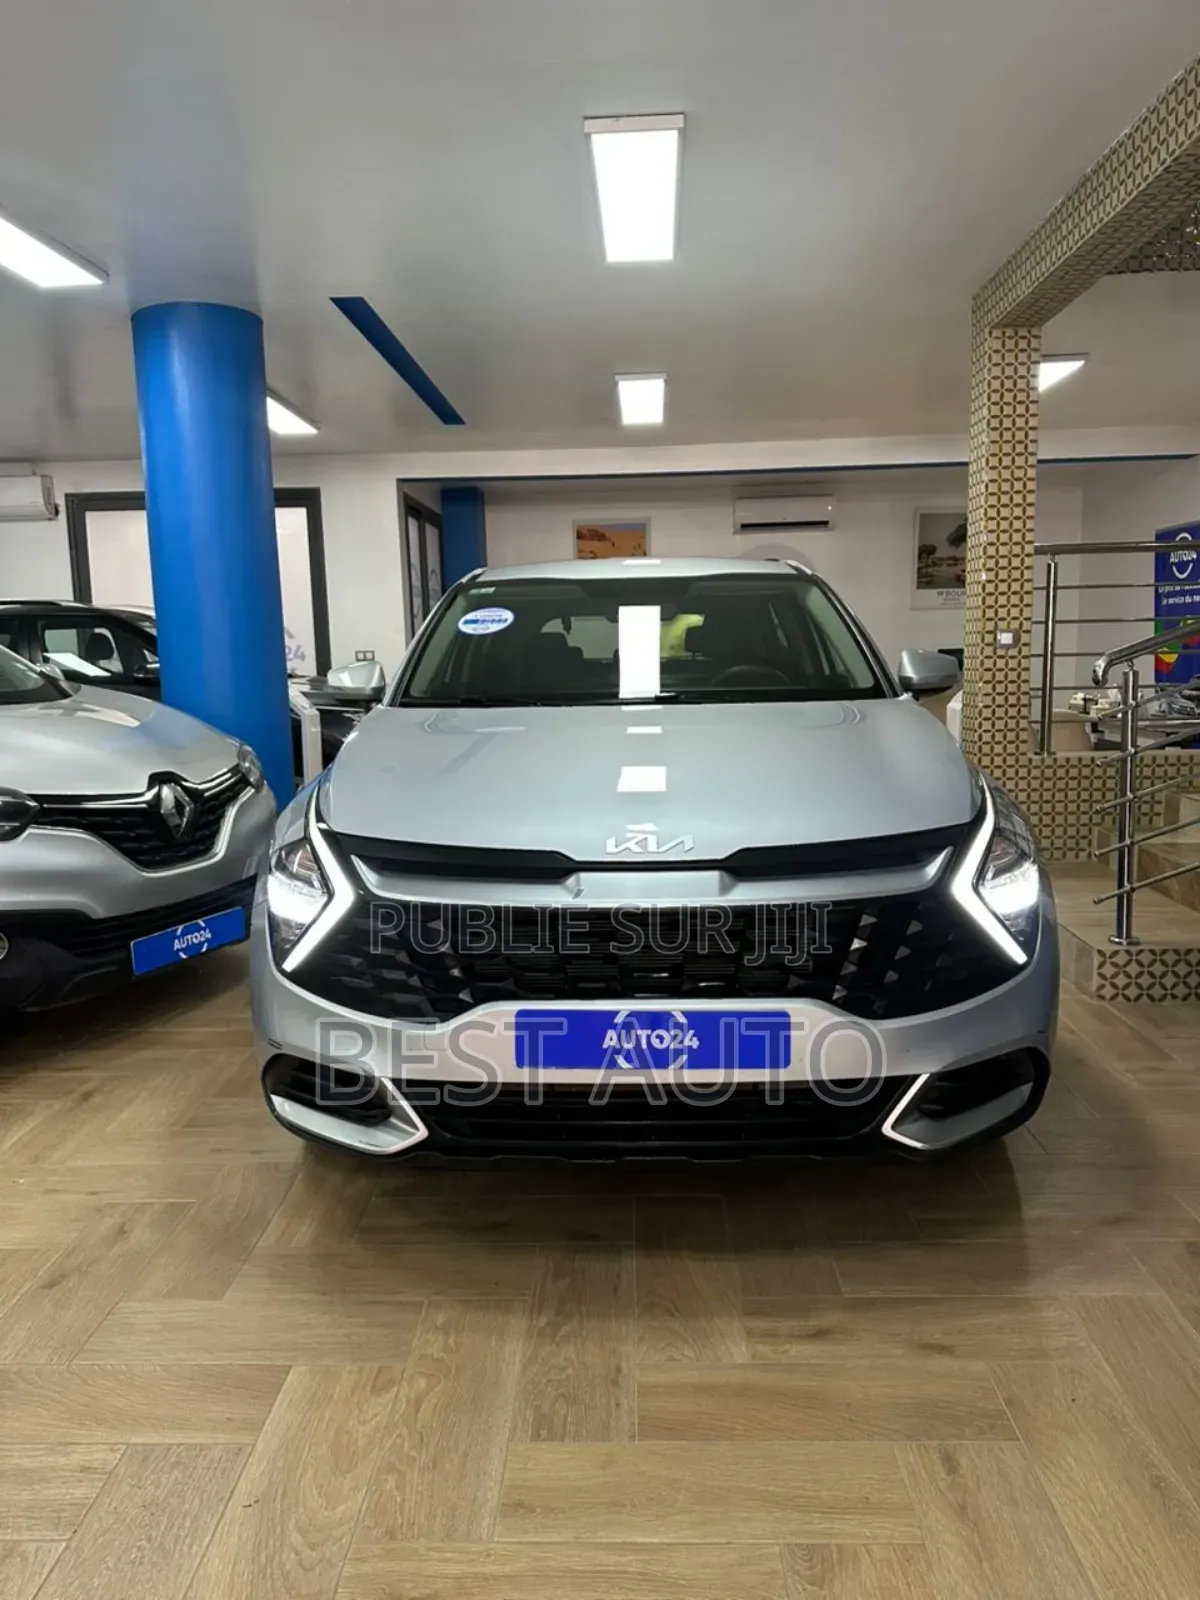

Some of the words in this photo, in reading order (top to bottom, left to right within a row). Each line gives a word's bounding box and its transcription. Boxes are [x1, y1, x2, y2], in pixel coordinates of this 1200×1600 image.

[1170, 550, 1197, 563] AUTO24
[173, 928, 212, 951] AUTO24
[602, 1028, 700, 1050] AUTO24
